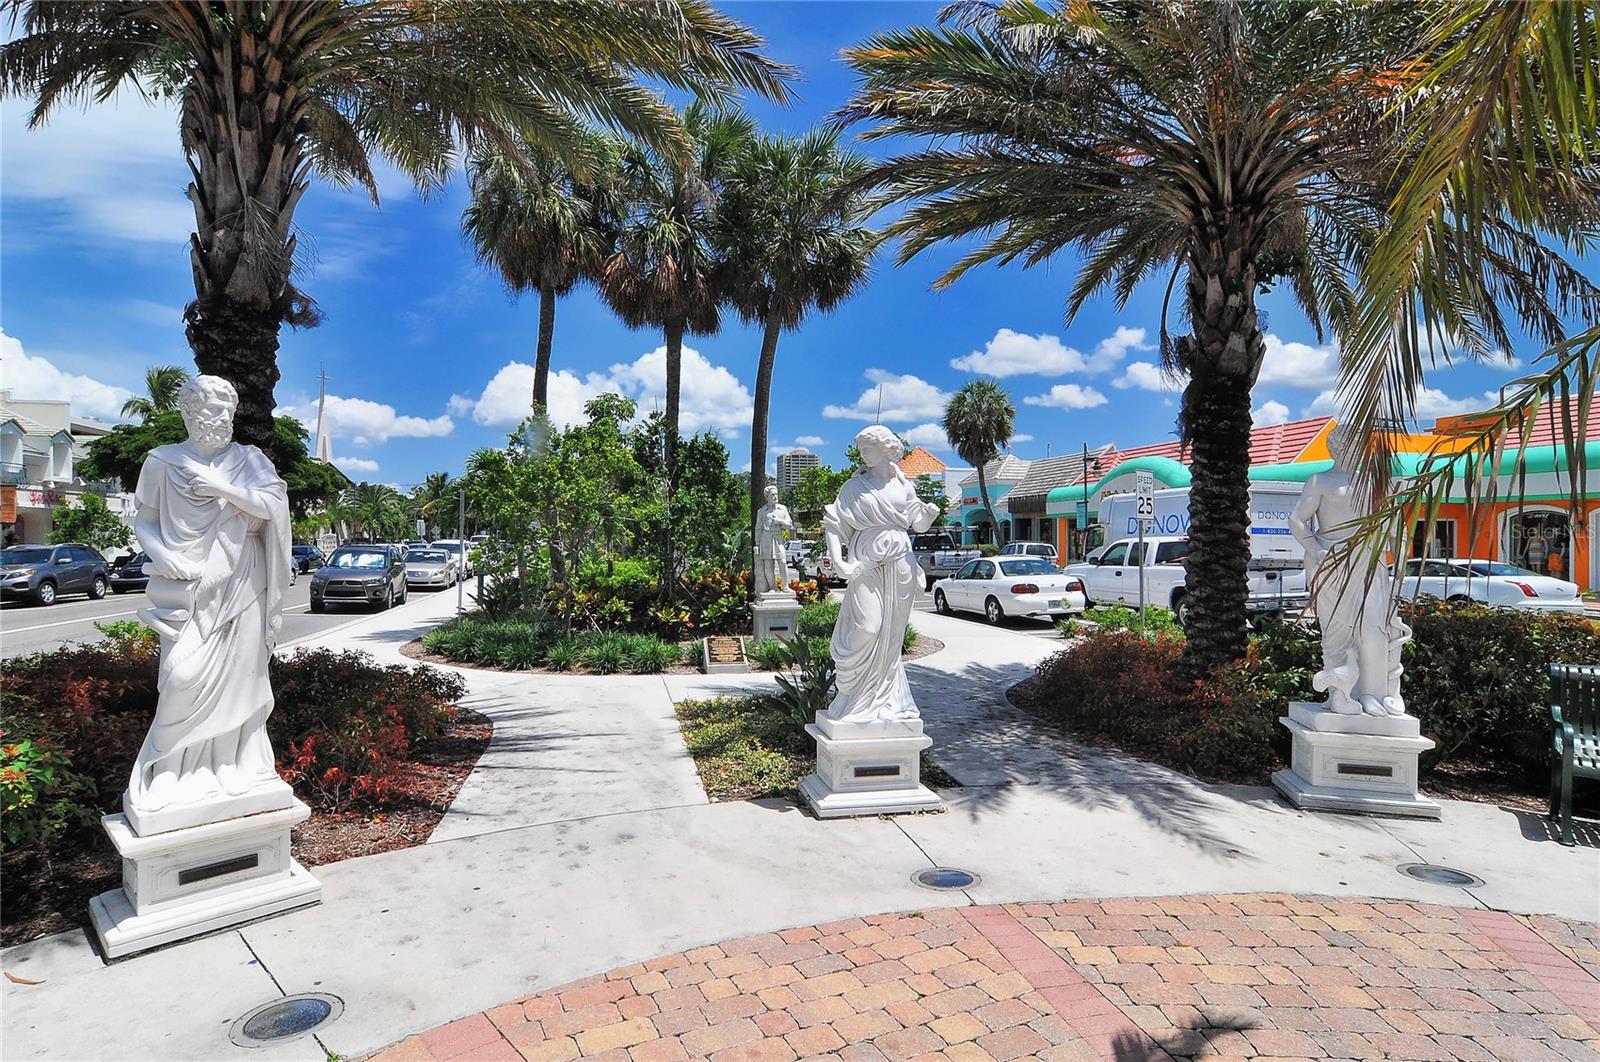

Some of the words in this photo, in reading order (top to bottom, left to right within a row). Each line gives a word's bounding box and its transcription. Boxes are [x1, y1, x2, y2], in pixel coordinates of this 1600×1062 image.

[1137, 475, 1152, 485] SPEED
[1138, 486, 1151, 495] LIMIT
[1138, 496, 1153, 515] 25
